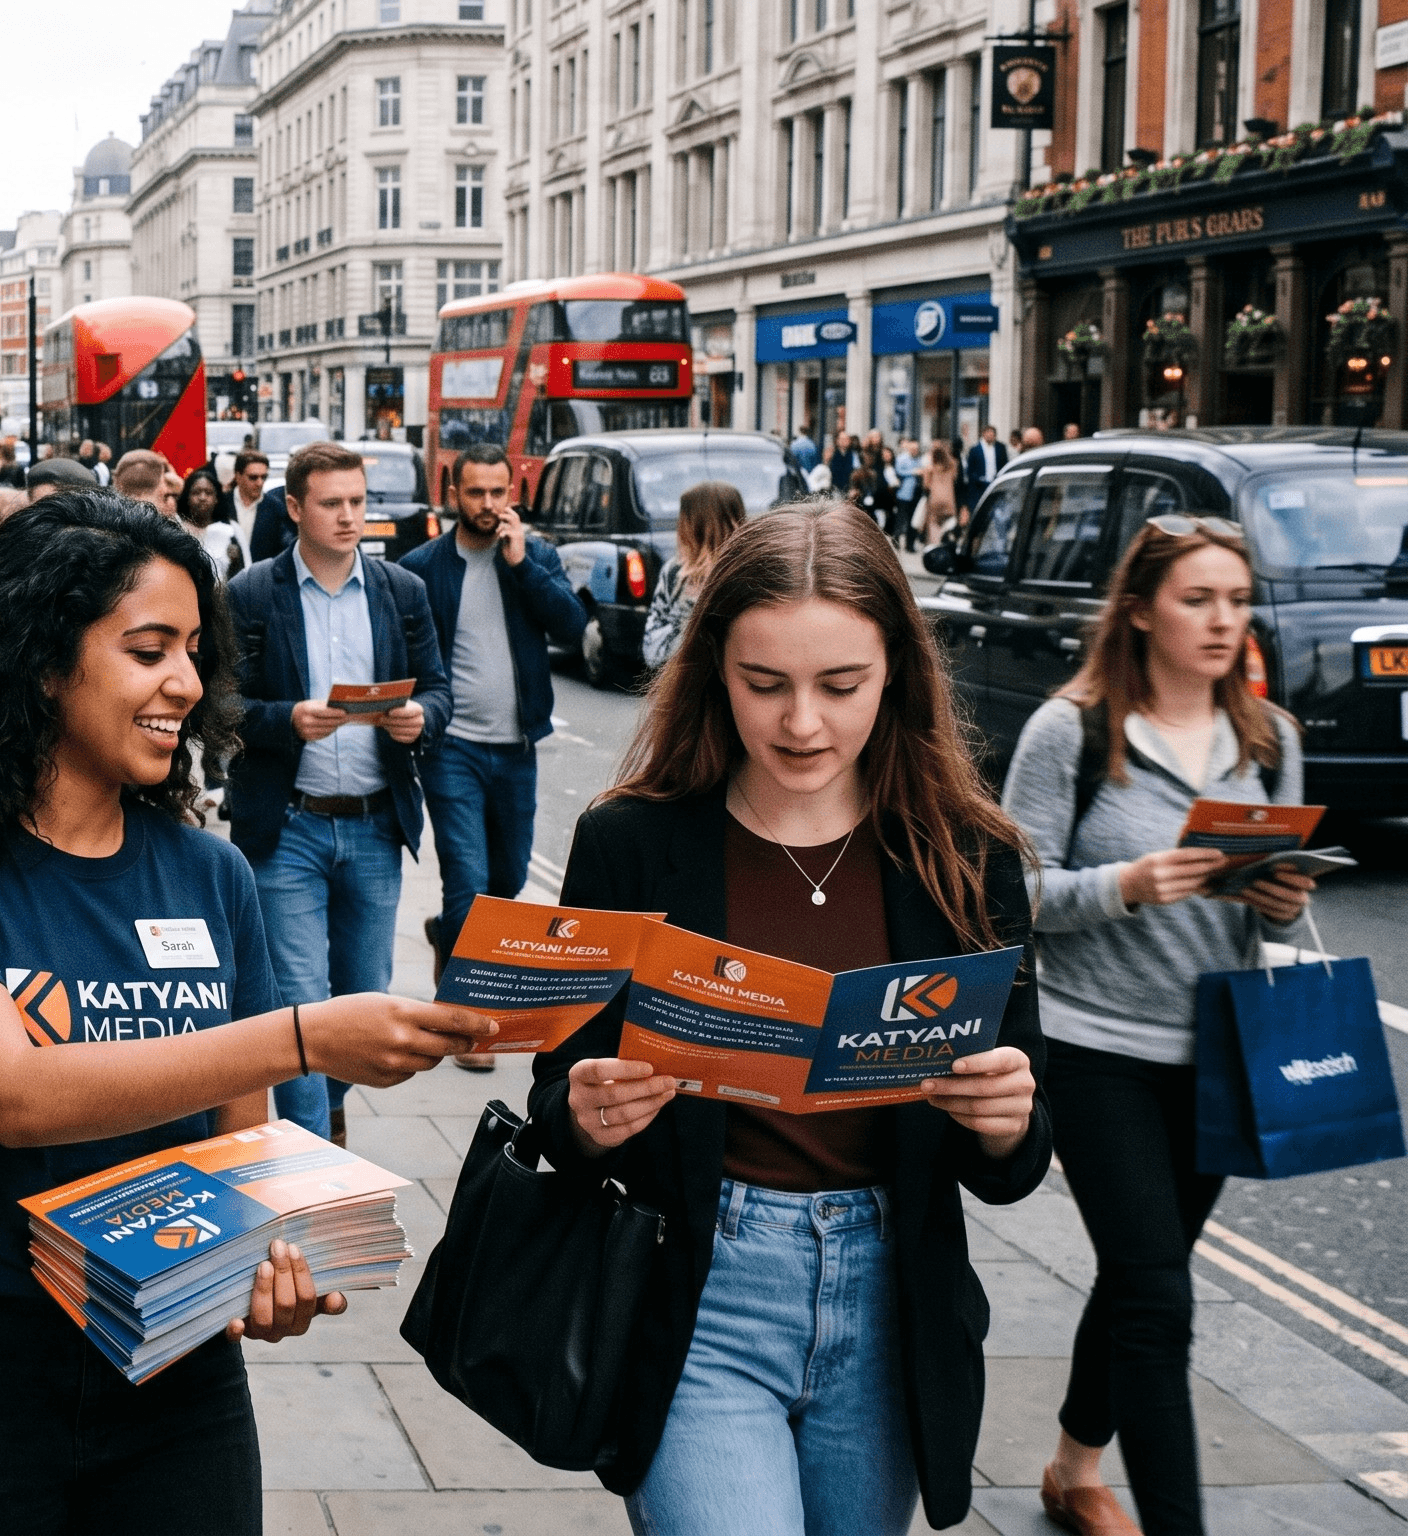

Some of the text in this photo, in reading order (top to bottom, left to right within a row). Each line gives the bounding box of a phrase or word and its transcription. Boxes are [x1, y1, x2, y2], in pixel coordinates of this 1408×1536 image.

[1122, 225, 1152, 249] THE
[161, 940, 195, 951] Sarah
[500, 938, 563, 954] KATYANI
[565, 945, 609, 956] MEDIA
[77, 980, 227, 1010] KATYANI
[673, 969, 734, 995] KATYANI
[738, 988, 785, 1006] MEDIA
[837, 1018, 982, 1048] KATYANI
[855, 1042, 955, 1062] MEDIA
[102, 1190, 217, 1243] KATYANI
[105, 1190, 184, 1225] MEDIA
